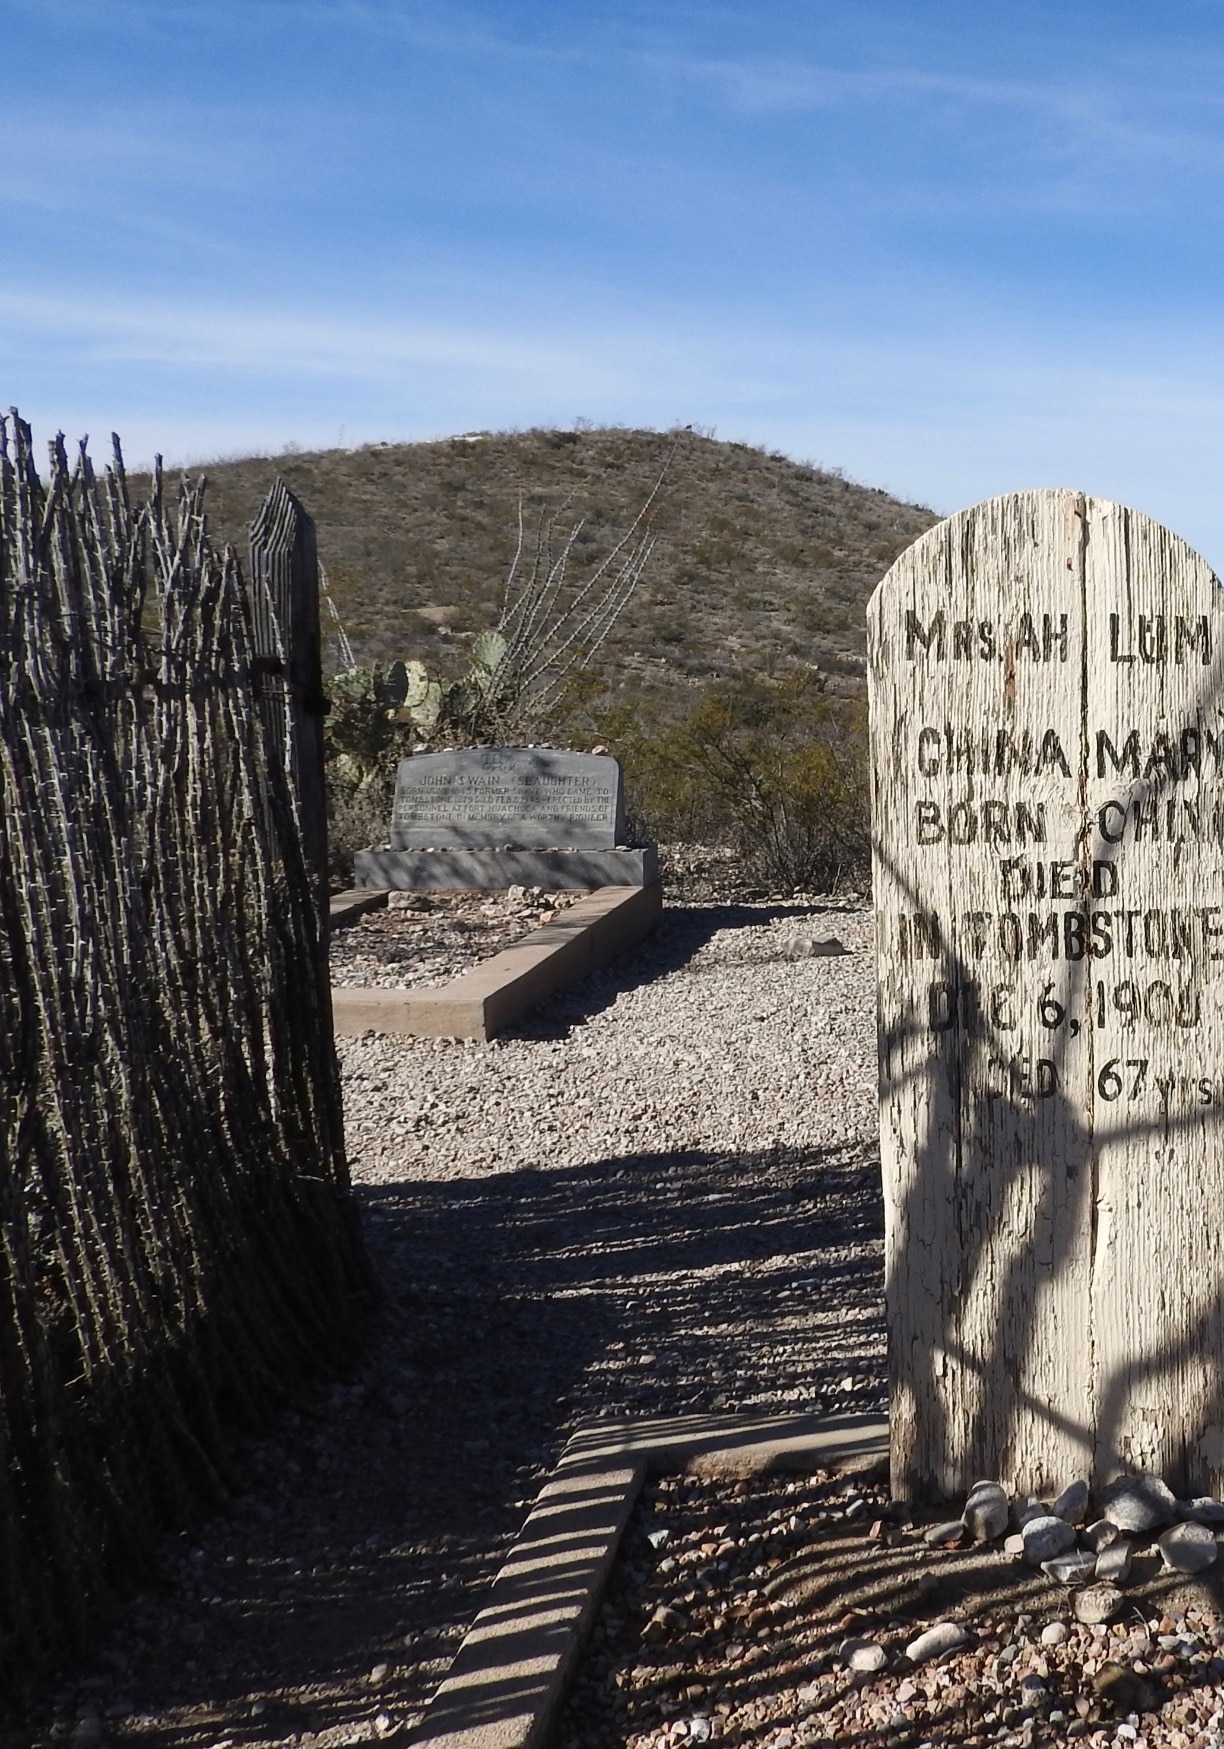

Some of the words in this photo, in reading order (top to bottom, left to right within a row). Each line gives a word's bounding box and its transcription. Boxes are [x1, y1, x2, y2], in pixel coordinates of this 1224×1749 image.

[1016, 612, 1069, 663] AH
[1109, 612, 1212, 665] LUM
[420, 775, 452, 786] JOHN
[458, 775, 500, 786] SWAIN
[597, 788, 609, 796] TO
[451, 804, 462, 813] AT
[598, 805, 610, 813] OF
[916, 800, 1048, 846] BORN
[1000, 858, 1119, 901] DIED
[897, 911, 940, 960] IN
[963, 907, 1224, 961] TOMBSTONE
[1097, 1057, 1150, 1102] 67
